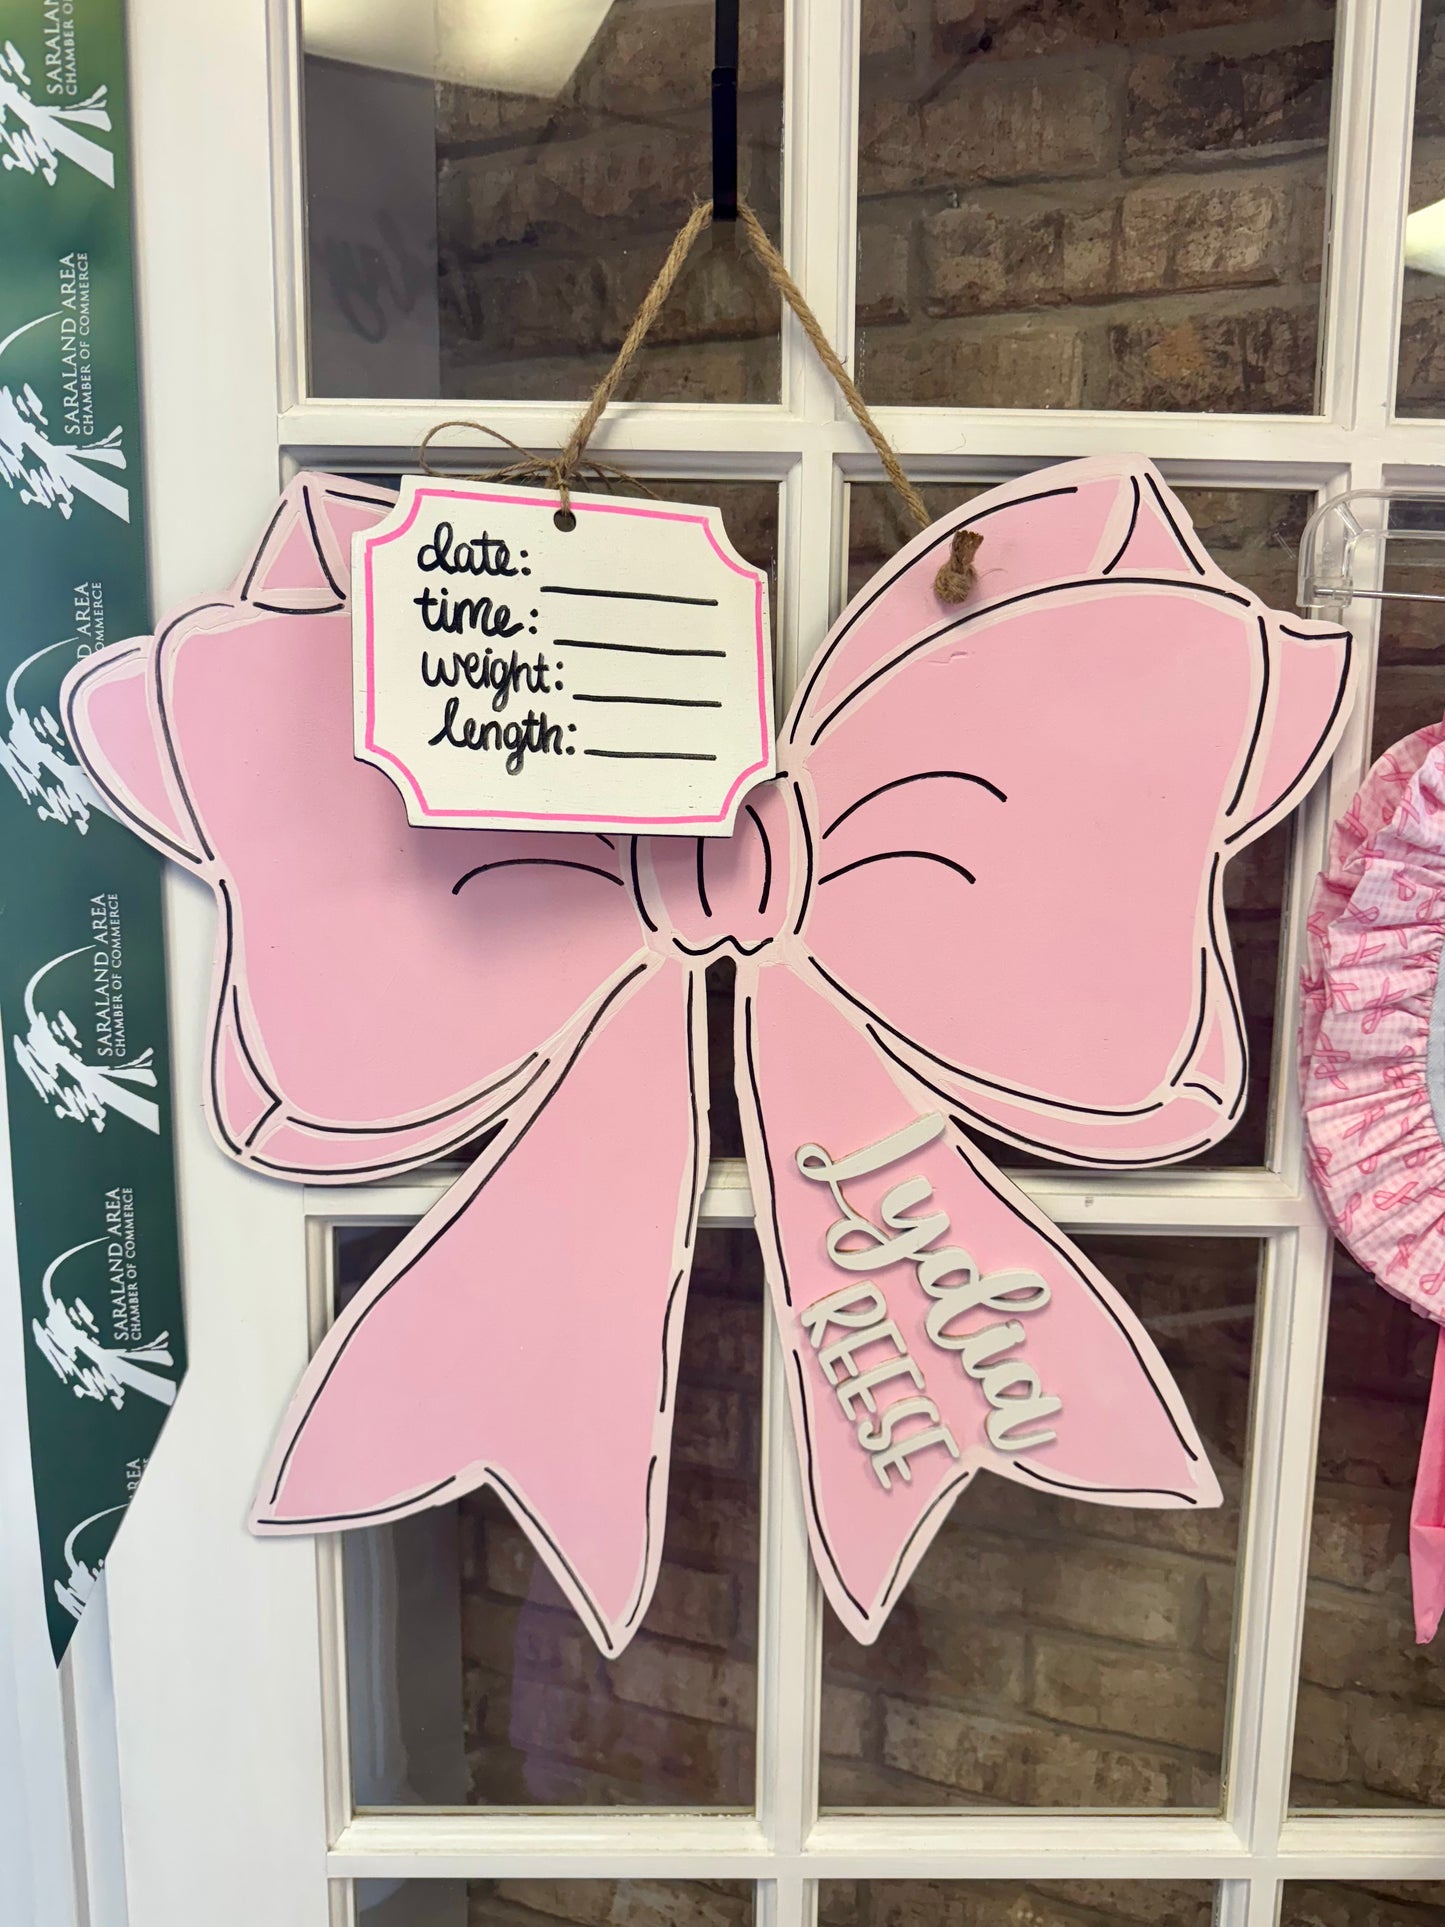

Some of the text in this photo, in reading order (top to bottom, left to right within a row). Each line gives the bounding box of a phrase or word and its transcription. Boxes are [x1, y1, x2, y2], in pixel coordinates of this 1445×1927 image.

[62, 0, 78, 96] CHAMBER O
[59, 252, 81, 436] SARALAND AREA
[76, 252, 95, 436] CHAMBER OF COMMERCE
[73, 581, 92, 637] AREA
[91, 582, 105, 651] OMMERCE
[413, 586, 539, 638] time:
[417, 521, 532, 577] date:
[421, 647, 564, 712] weight:
[428, 696, 578, 776] length:
[90, 893, 114, 1058] SARALAND AREA
[107, 893, 127, 1058] CHAMBER OF COMMERCE
[104, 1187, 130, 1342] SARALAND AREA
[122, 1187, 143, 1342] CHAMBER OF COMMERCE
[795, 1111, 1063, 1451] Lydia
[800, 1280, 961, 1490] REESE
